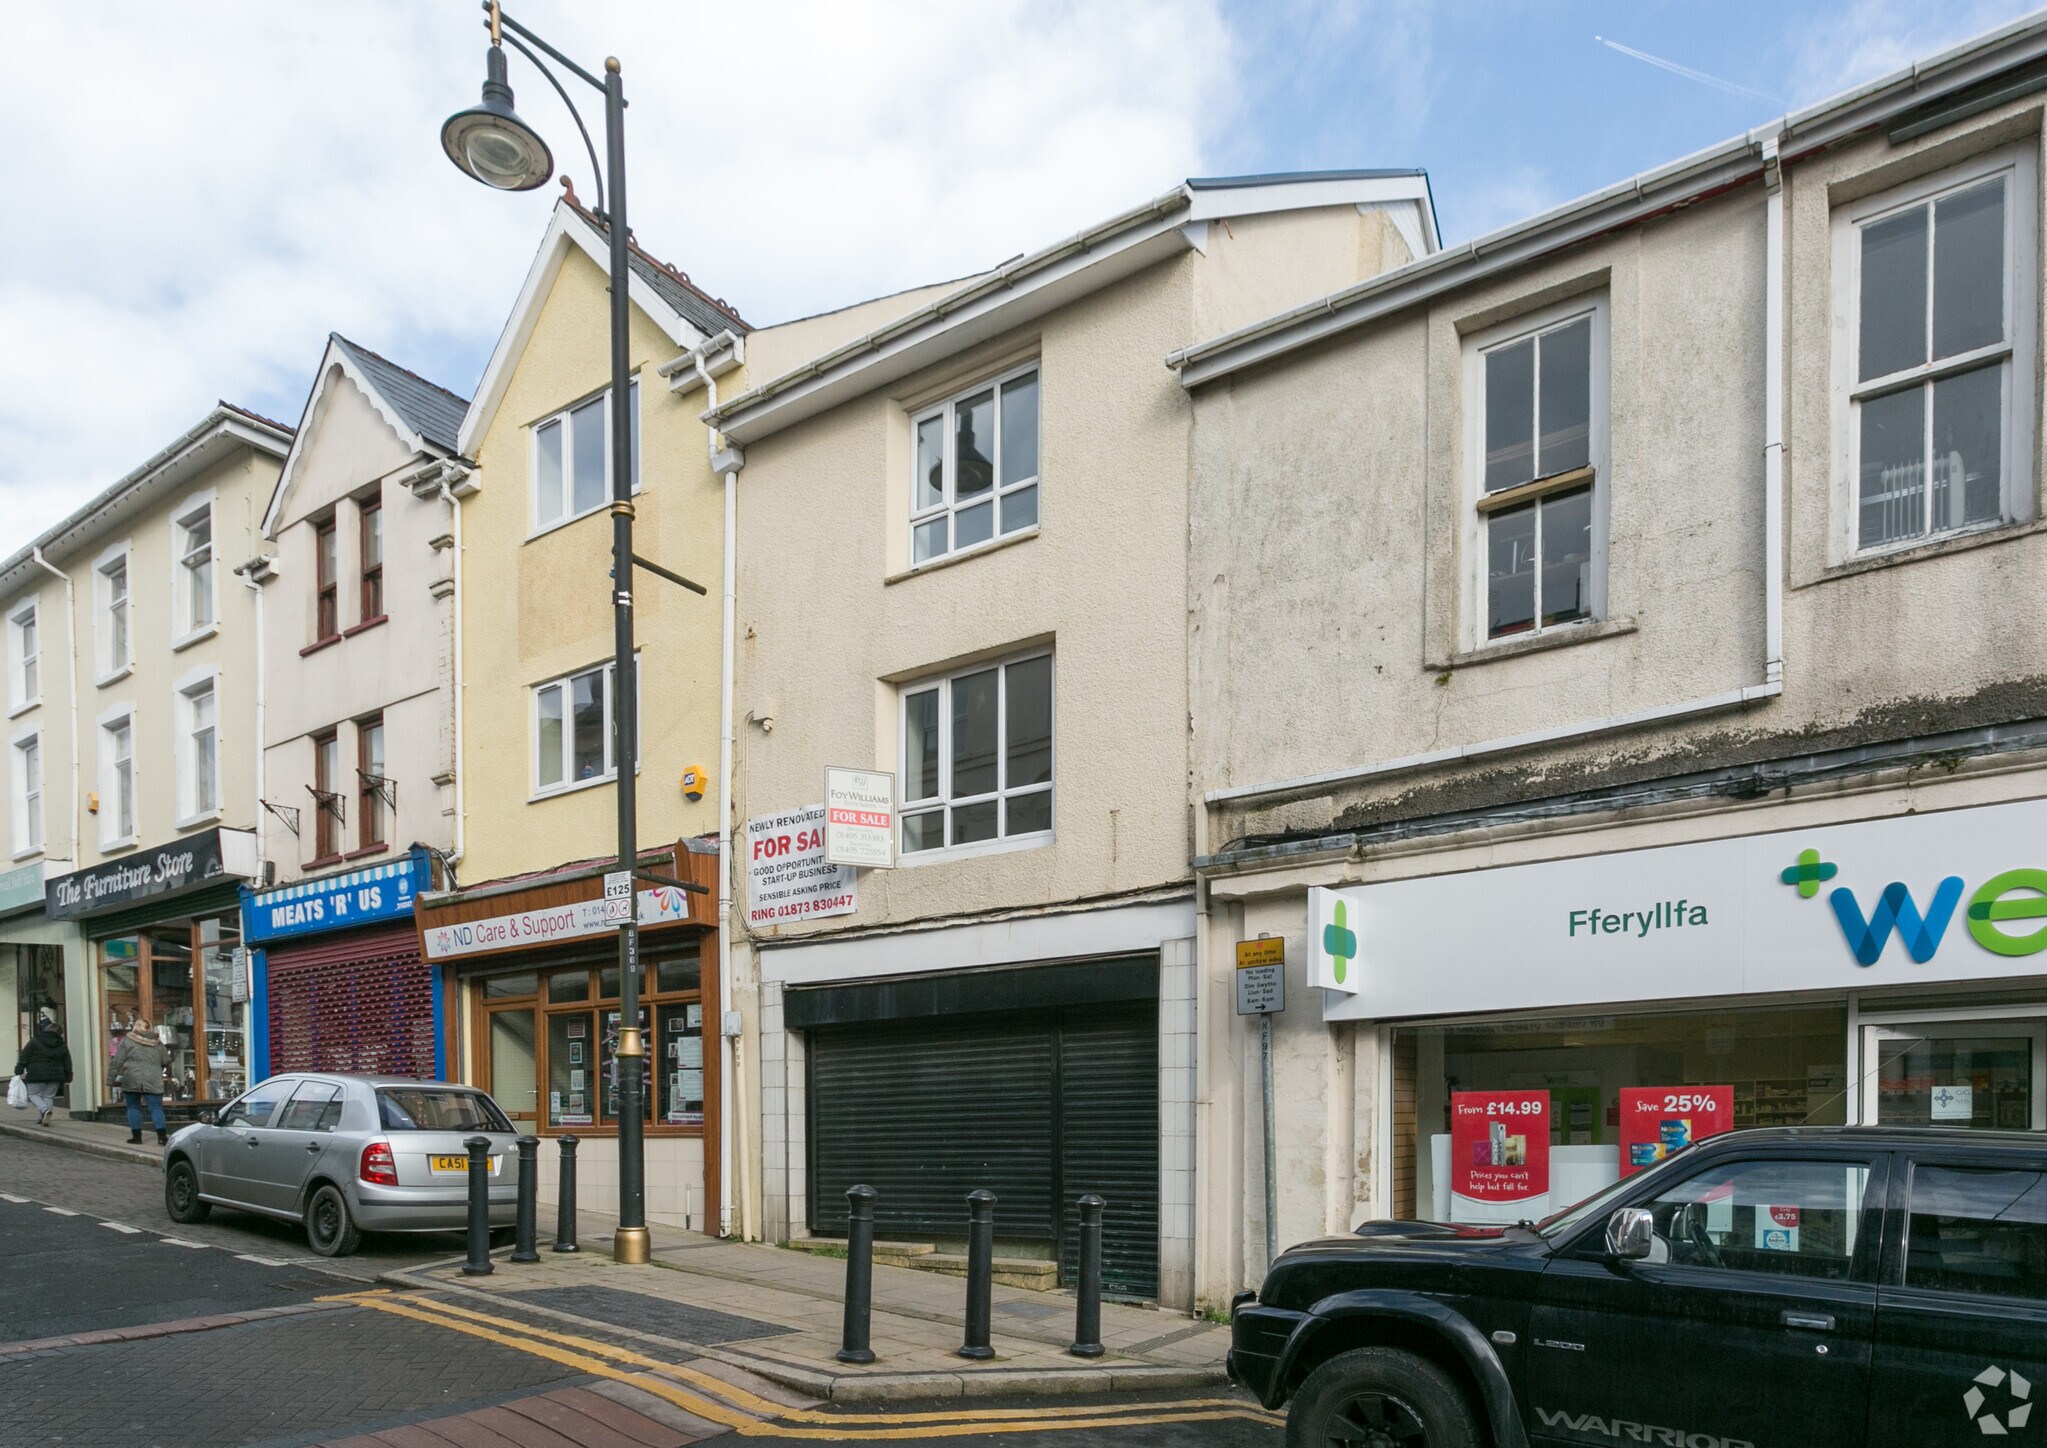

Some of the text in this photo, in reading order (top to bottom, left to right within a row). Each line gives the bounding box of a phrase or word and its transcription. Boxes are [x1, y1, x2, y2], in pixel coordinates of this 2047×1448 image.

[749, 808, 826, 834] NEWLY RENOVATED
[832, 810, 888, 826] FOR SALE
[753, 834, 791, 861] FOR
[753, 865, 775, 877] GOOD
[776, 855, 825, 873] OPPORTUNIT
[762, 864, 838, 886] START-UP BUSINESS
[56, 875, 81, 907] The
[83, 864, 152, 900] Furniture
[154, 851, 194, 883] Store
[606, 884, 630, 897] £125
[759, 880, 842, 902] SENSIBLE ASKING PRICE
[271, 886, 383, 930] MEATS 'R' US
[751, 894, 853, 921] RING 01873 830447
[1568, 899, 1708, 938] Fferyllfa
[1829, 868, 2047, 968] we
[453, 909, 576, 947] ND Care & Support
[1252, 950, 1263, 958] any
[1255, 967, 1275, 975] loading
[1458, 1101, 1542, 1115] From £14.99
[1634, 1094, 1716, 1113] Save 25%
[1469, 1181, 1485, 1193] help
[1487, 1181, 1500, 1190] but
[1502, 1182, 1514, 1190] fall
[1470, 1170, 1529, 1182] Prices you can't
[1533, 1338, 1585, 1351] L200
